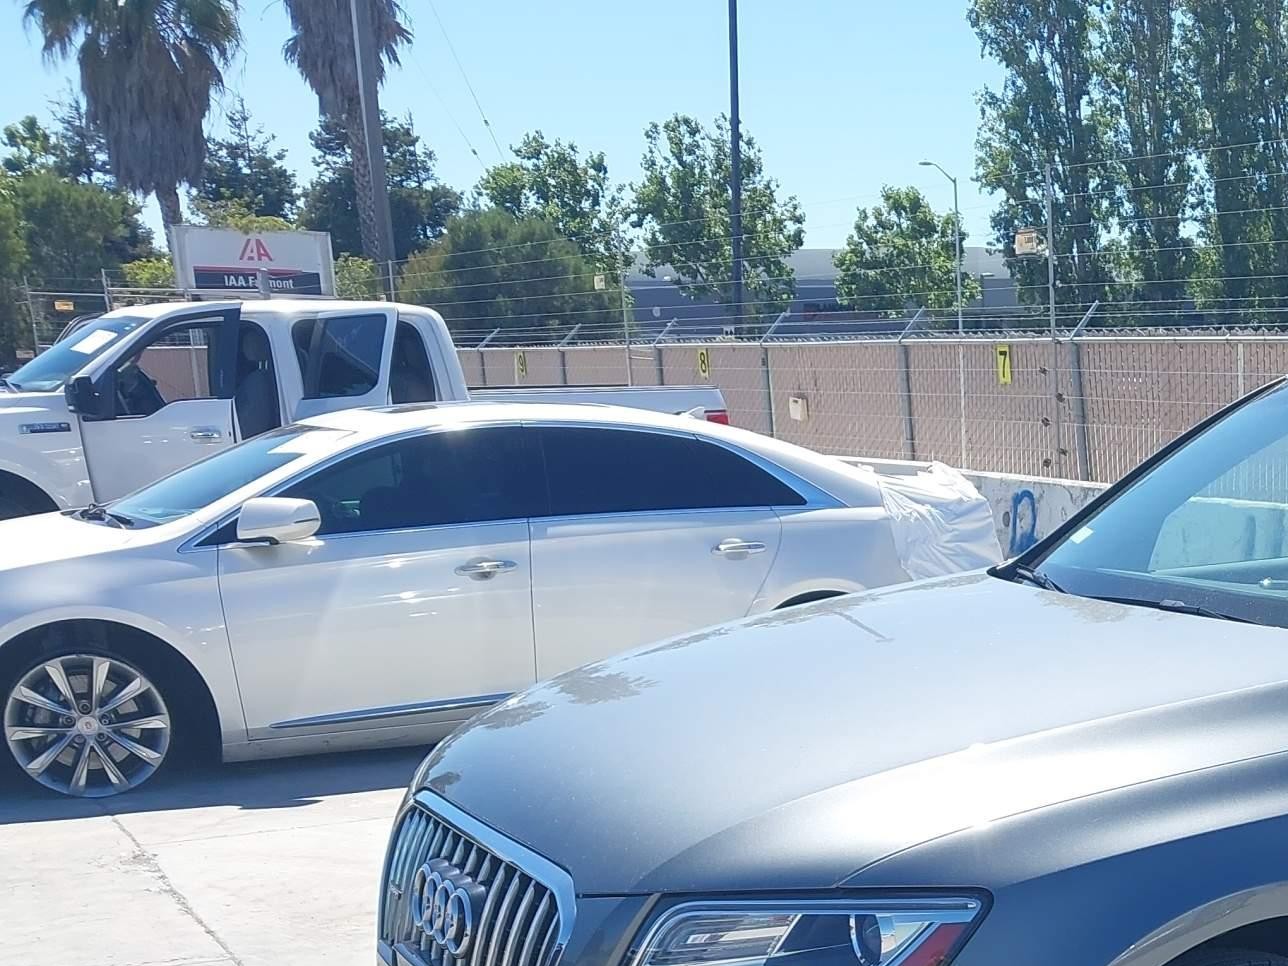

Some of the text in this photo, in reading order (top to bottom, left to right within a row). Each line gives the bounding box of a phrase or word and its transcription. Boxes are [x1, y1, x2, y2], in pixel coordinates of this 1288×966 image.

[224, 275, 294, 289] IAA Fmont
[700, 352, 707, 373] 8
[999, 350, 1007, 378] 7
